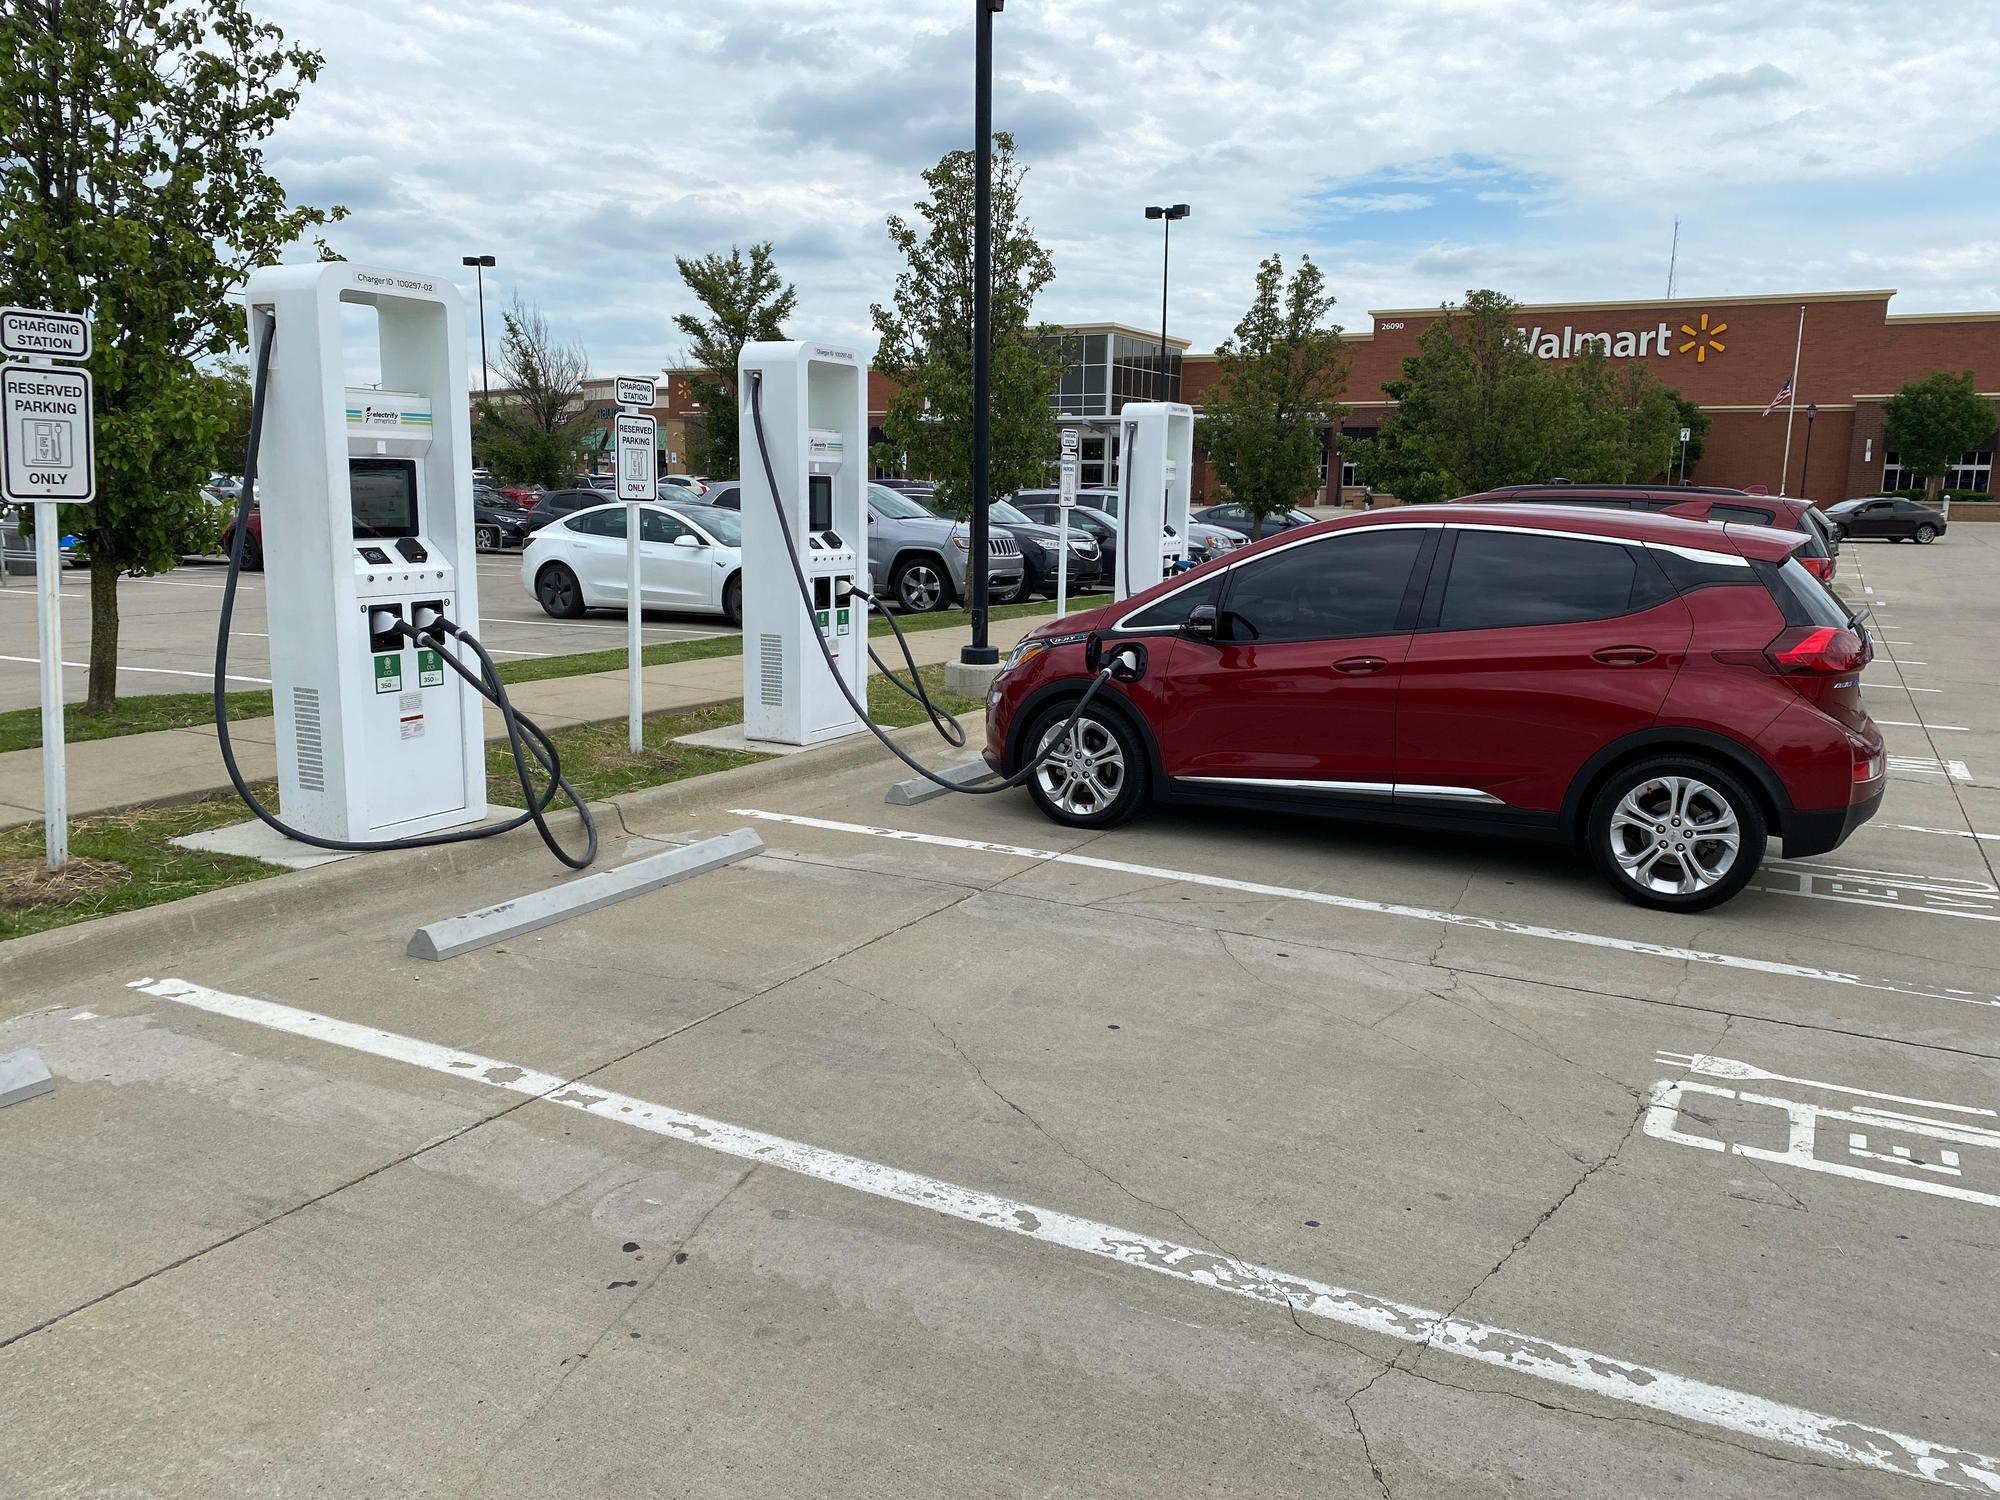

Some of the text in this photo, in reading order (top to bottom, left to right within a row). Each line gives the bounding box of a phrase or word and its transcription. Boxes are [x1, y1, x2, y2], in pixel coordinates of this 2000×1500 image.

[357, 273, 433, 291] Charger ID 100297-02
[8, 318, 80, 336] CHARGING
[1381, 321, 1405, 331] 26090
[17, 334, 73, 349] STATION
[1503, 322, 1672, 360] Walmart
[7, 381, 83, 398] RESERVED
[619, 381, 651, 392] CHARGING
[623, 392, 648, 401] STATION
[15, 399, 78, 415] PARKING
[372, 411, 399, 420] electrify
[619, 424, 653, 435] RESERVED
[622, 435, 651, 446] PARKING
[29, 472, 68, 485] ONLY
[627, 483, 646, 493] ONLY
